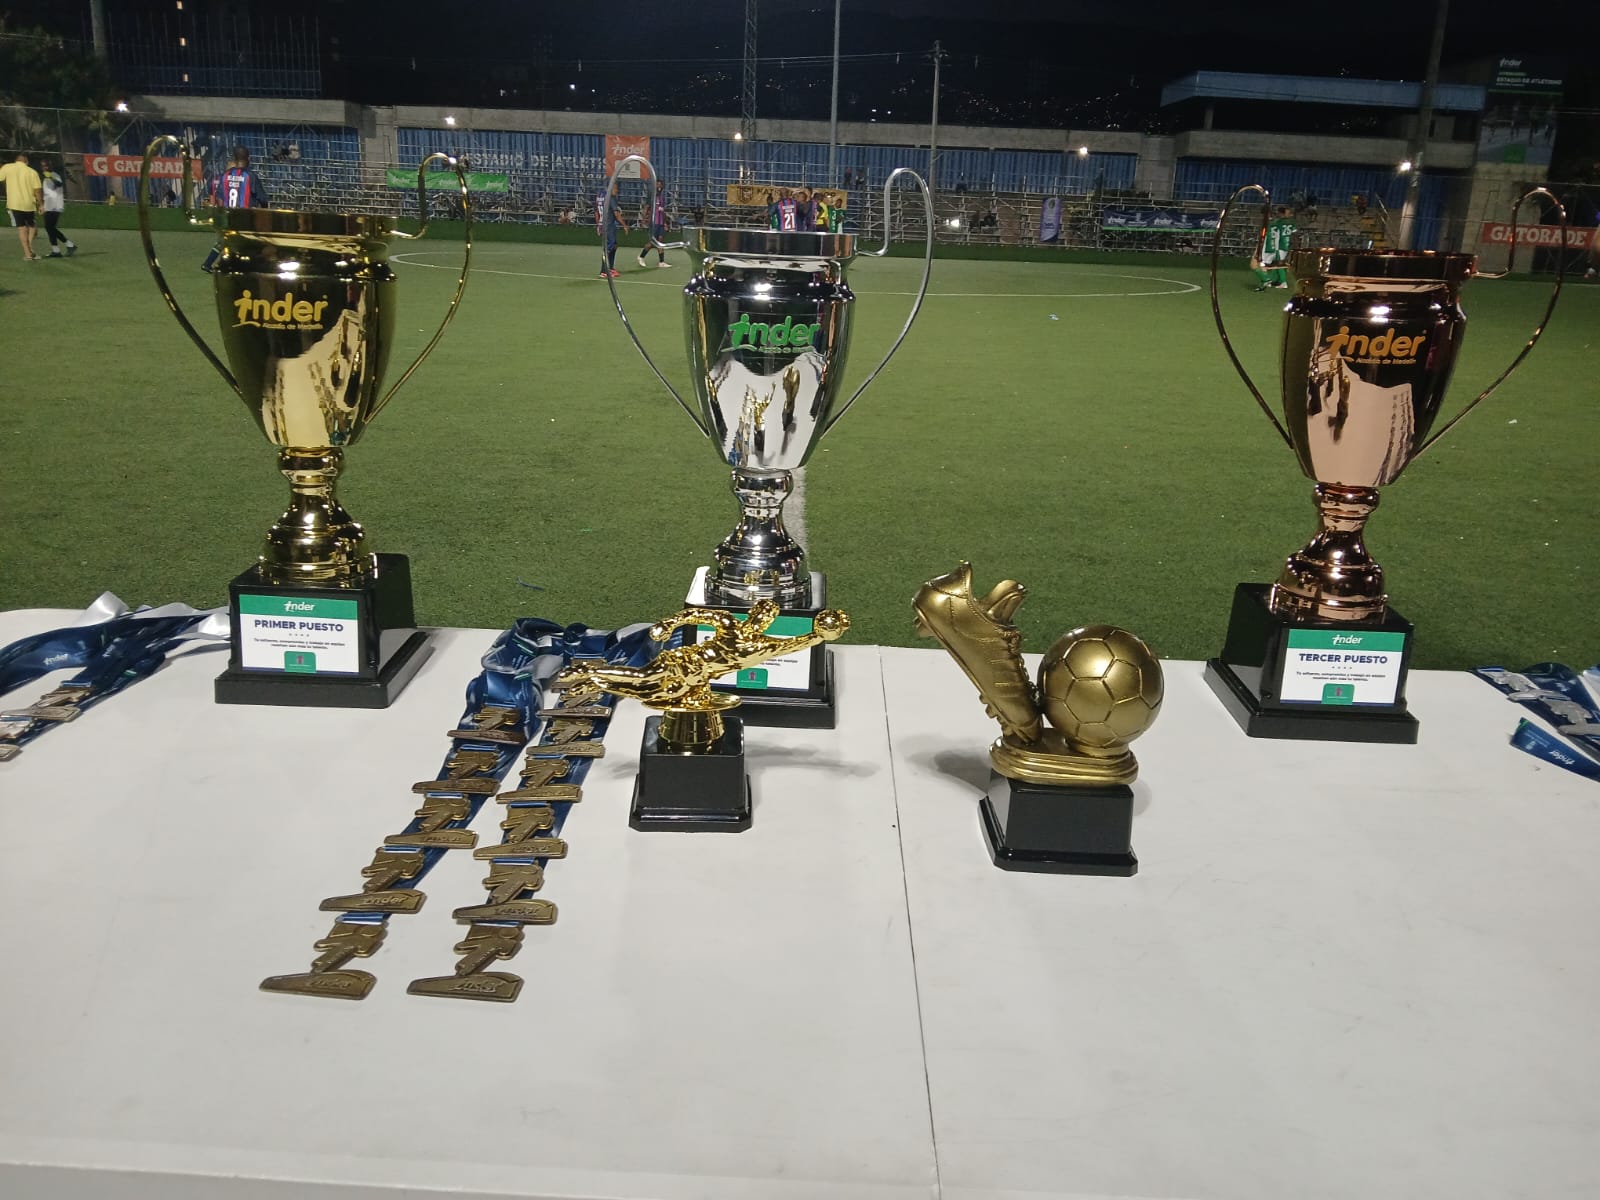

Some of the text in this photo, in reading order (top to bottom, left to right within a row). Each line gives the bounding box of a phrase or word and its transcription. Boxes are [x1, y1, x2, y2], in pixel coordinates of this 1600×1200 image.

[92, 157, 108, 174] G
[234, 289, 328, 324] inder
[728, 313, 821, 348] inder
[1326, 326, 1425, 357] inder
[284, 600, 316, 612] inder
[254, 619, 344, 632] PRIMER PUESTO
[1332, 634, 1364, 645] inder
[1298, 653, 1388, 665] TERCER PUESTO
